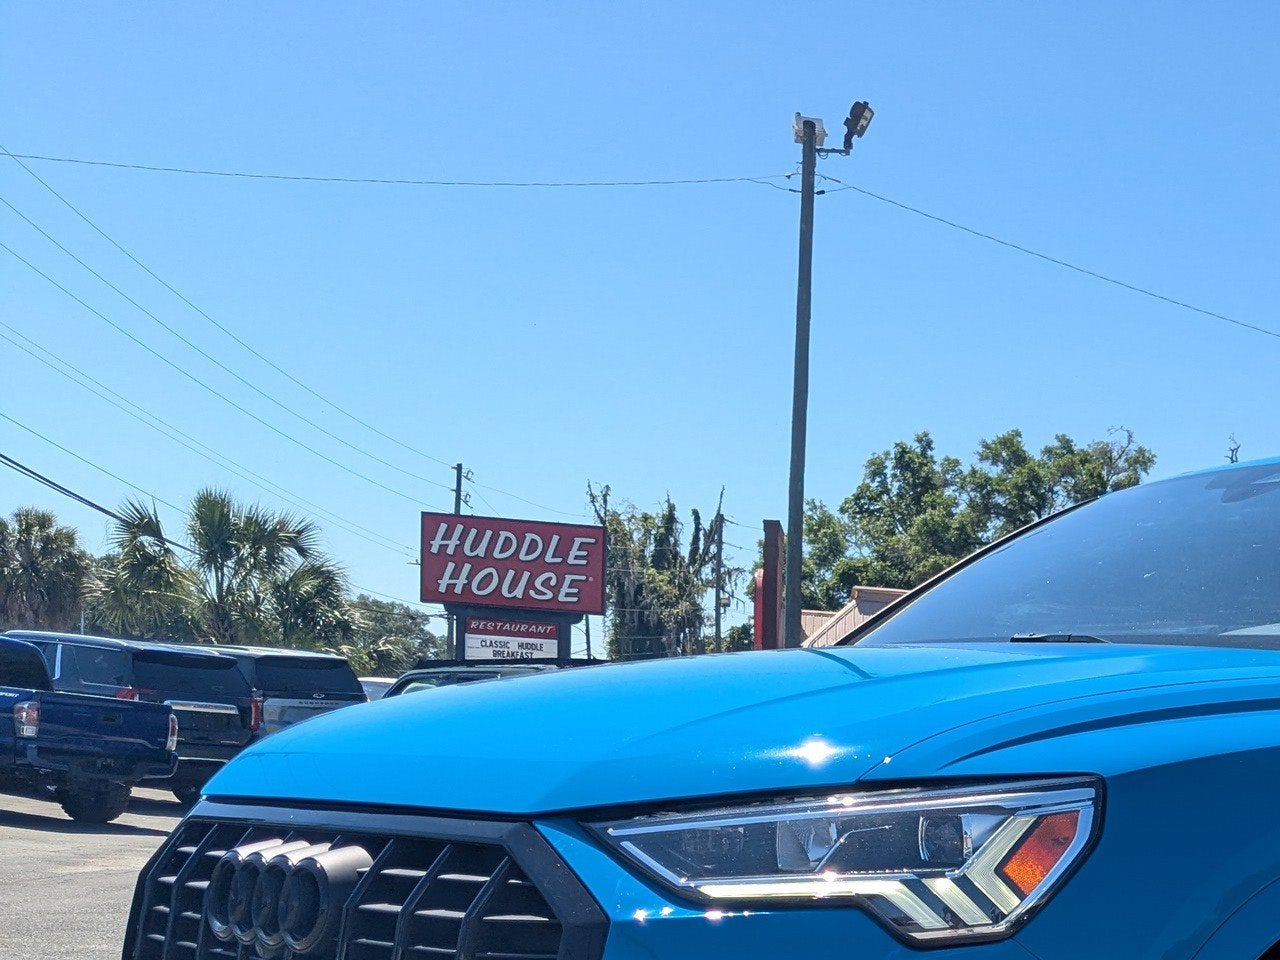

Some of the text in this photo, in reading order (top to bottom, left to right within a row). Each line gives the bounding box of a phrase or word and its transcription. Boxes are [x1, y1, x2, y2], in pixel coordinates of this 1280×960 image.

[430, 522, 596, 565] HUDDLE
[437, 561, 587, 602] HOUSE
[470, 620, 555, 634] RESTAURANT
[480, 639, 544, 652] CLASSIC HUDDLE
[492, 649, 535, 659] BREAKFAST
